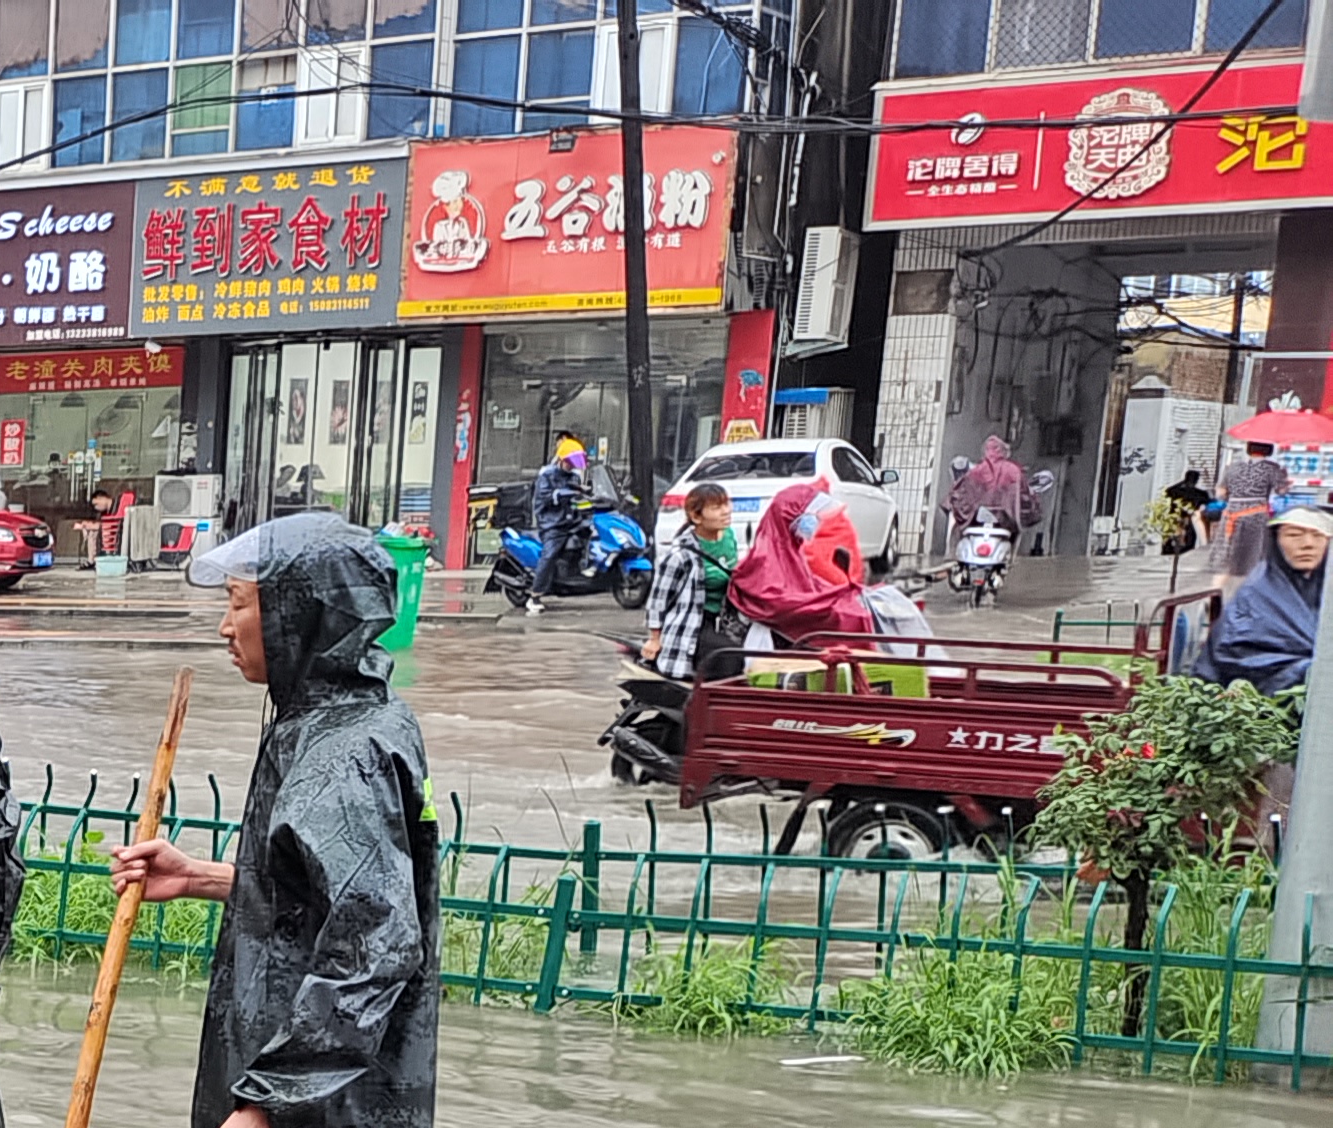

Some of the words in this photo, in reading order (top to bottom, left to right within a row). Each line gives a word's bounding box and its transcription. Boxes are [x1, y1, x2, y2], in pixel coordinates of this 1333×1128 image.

[1090, 124, 1149, 147] 沱牌
[907, 152, 1018, 181] 沱牌舍得
[1086, 146, 1148, 169] 天曲
[165, 165, 376, 198] 不满意就退货
[141, 191, 390, 281] 鲜到家食材
[546, 236, 607, 253] 五谷有根
[214, 279, 272, 299] 冷鲜猪肉
[310, 275, 340, 294] 火锅
[142, 305, 170, 323] 油炸
[178, 303, 204, 322] 面点
[213, 300, 271, 319] 冷冻食品
[6, 353, 173, 381] 老潼关肉夹馍
